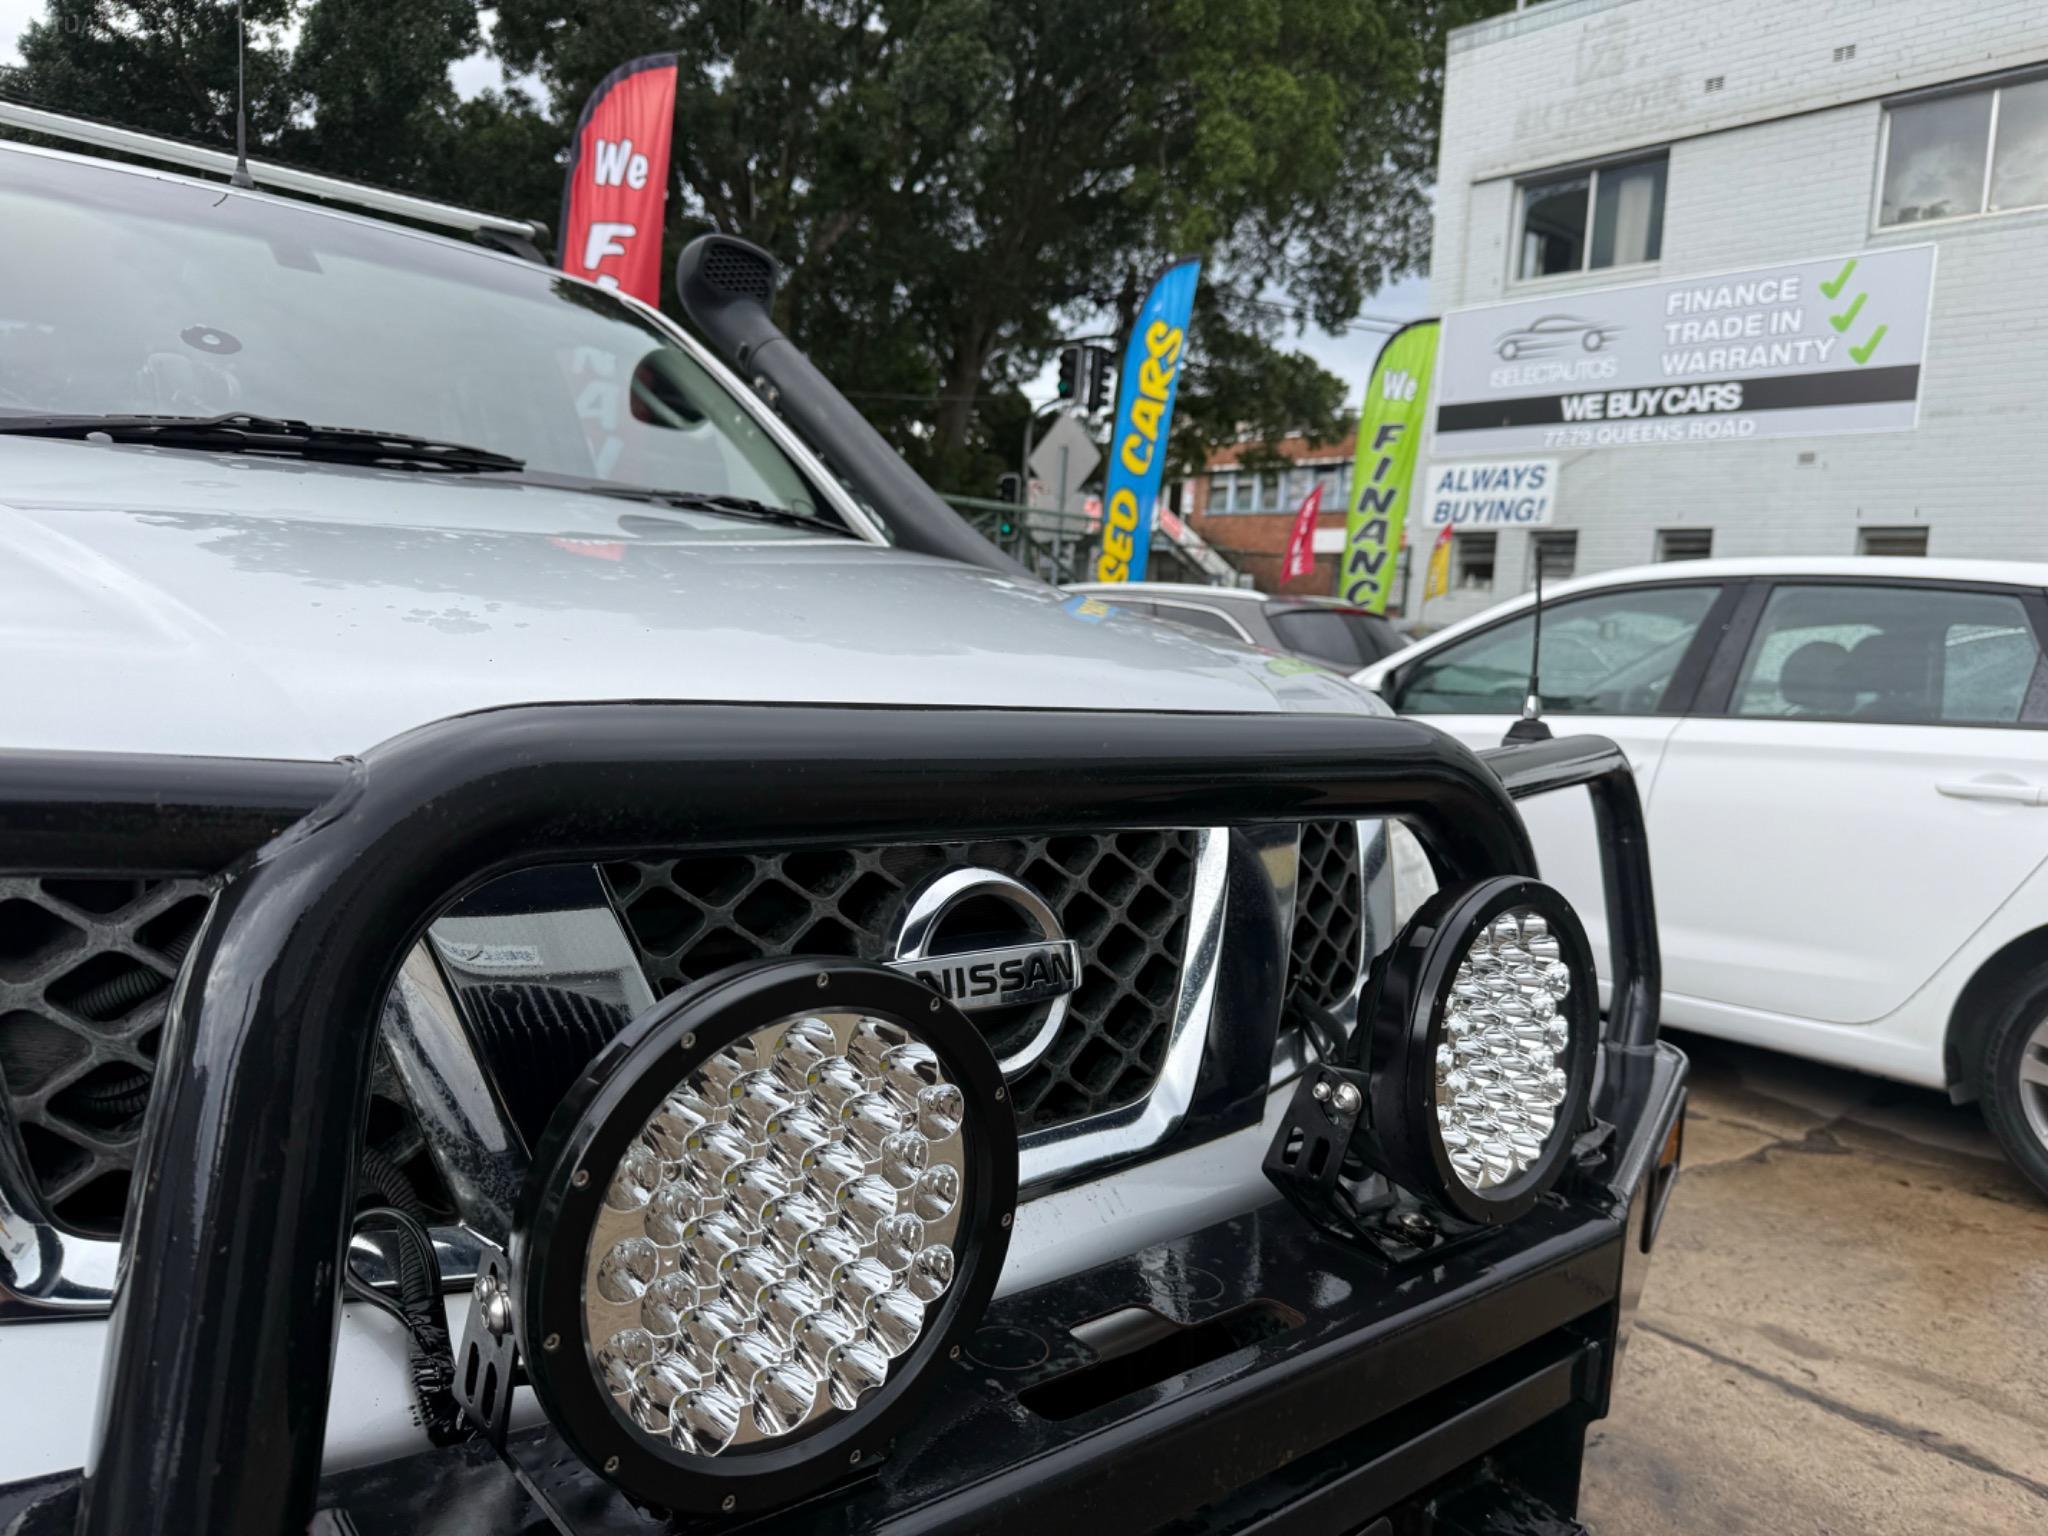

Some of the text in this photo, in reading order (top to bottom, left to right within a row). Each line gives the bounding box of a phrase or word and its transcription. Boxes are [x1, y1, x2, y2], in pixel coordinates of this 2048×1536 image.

[594, 138, 649, 190] We
[1666, 277, 1800, 316] FINANCE
[1664, 309, 1803, 345] TRADE IN
[1661, 336, 1836, 377] WARRANTY
[1121, 319, 1184, 476] CARS
[1383, 368, 1418, 402] We
[1560, 382, 1742, 421] WE BUY CARS
[1596, 422, 1684, 445] QUEENS
[1688, 418, 1756, 440] ROAD
[1436, 464, 1547, 494] ALWAYS
[1433, 498, 1546, 524] BUYING!
[914, 952, 1074, 999] NISSAN
